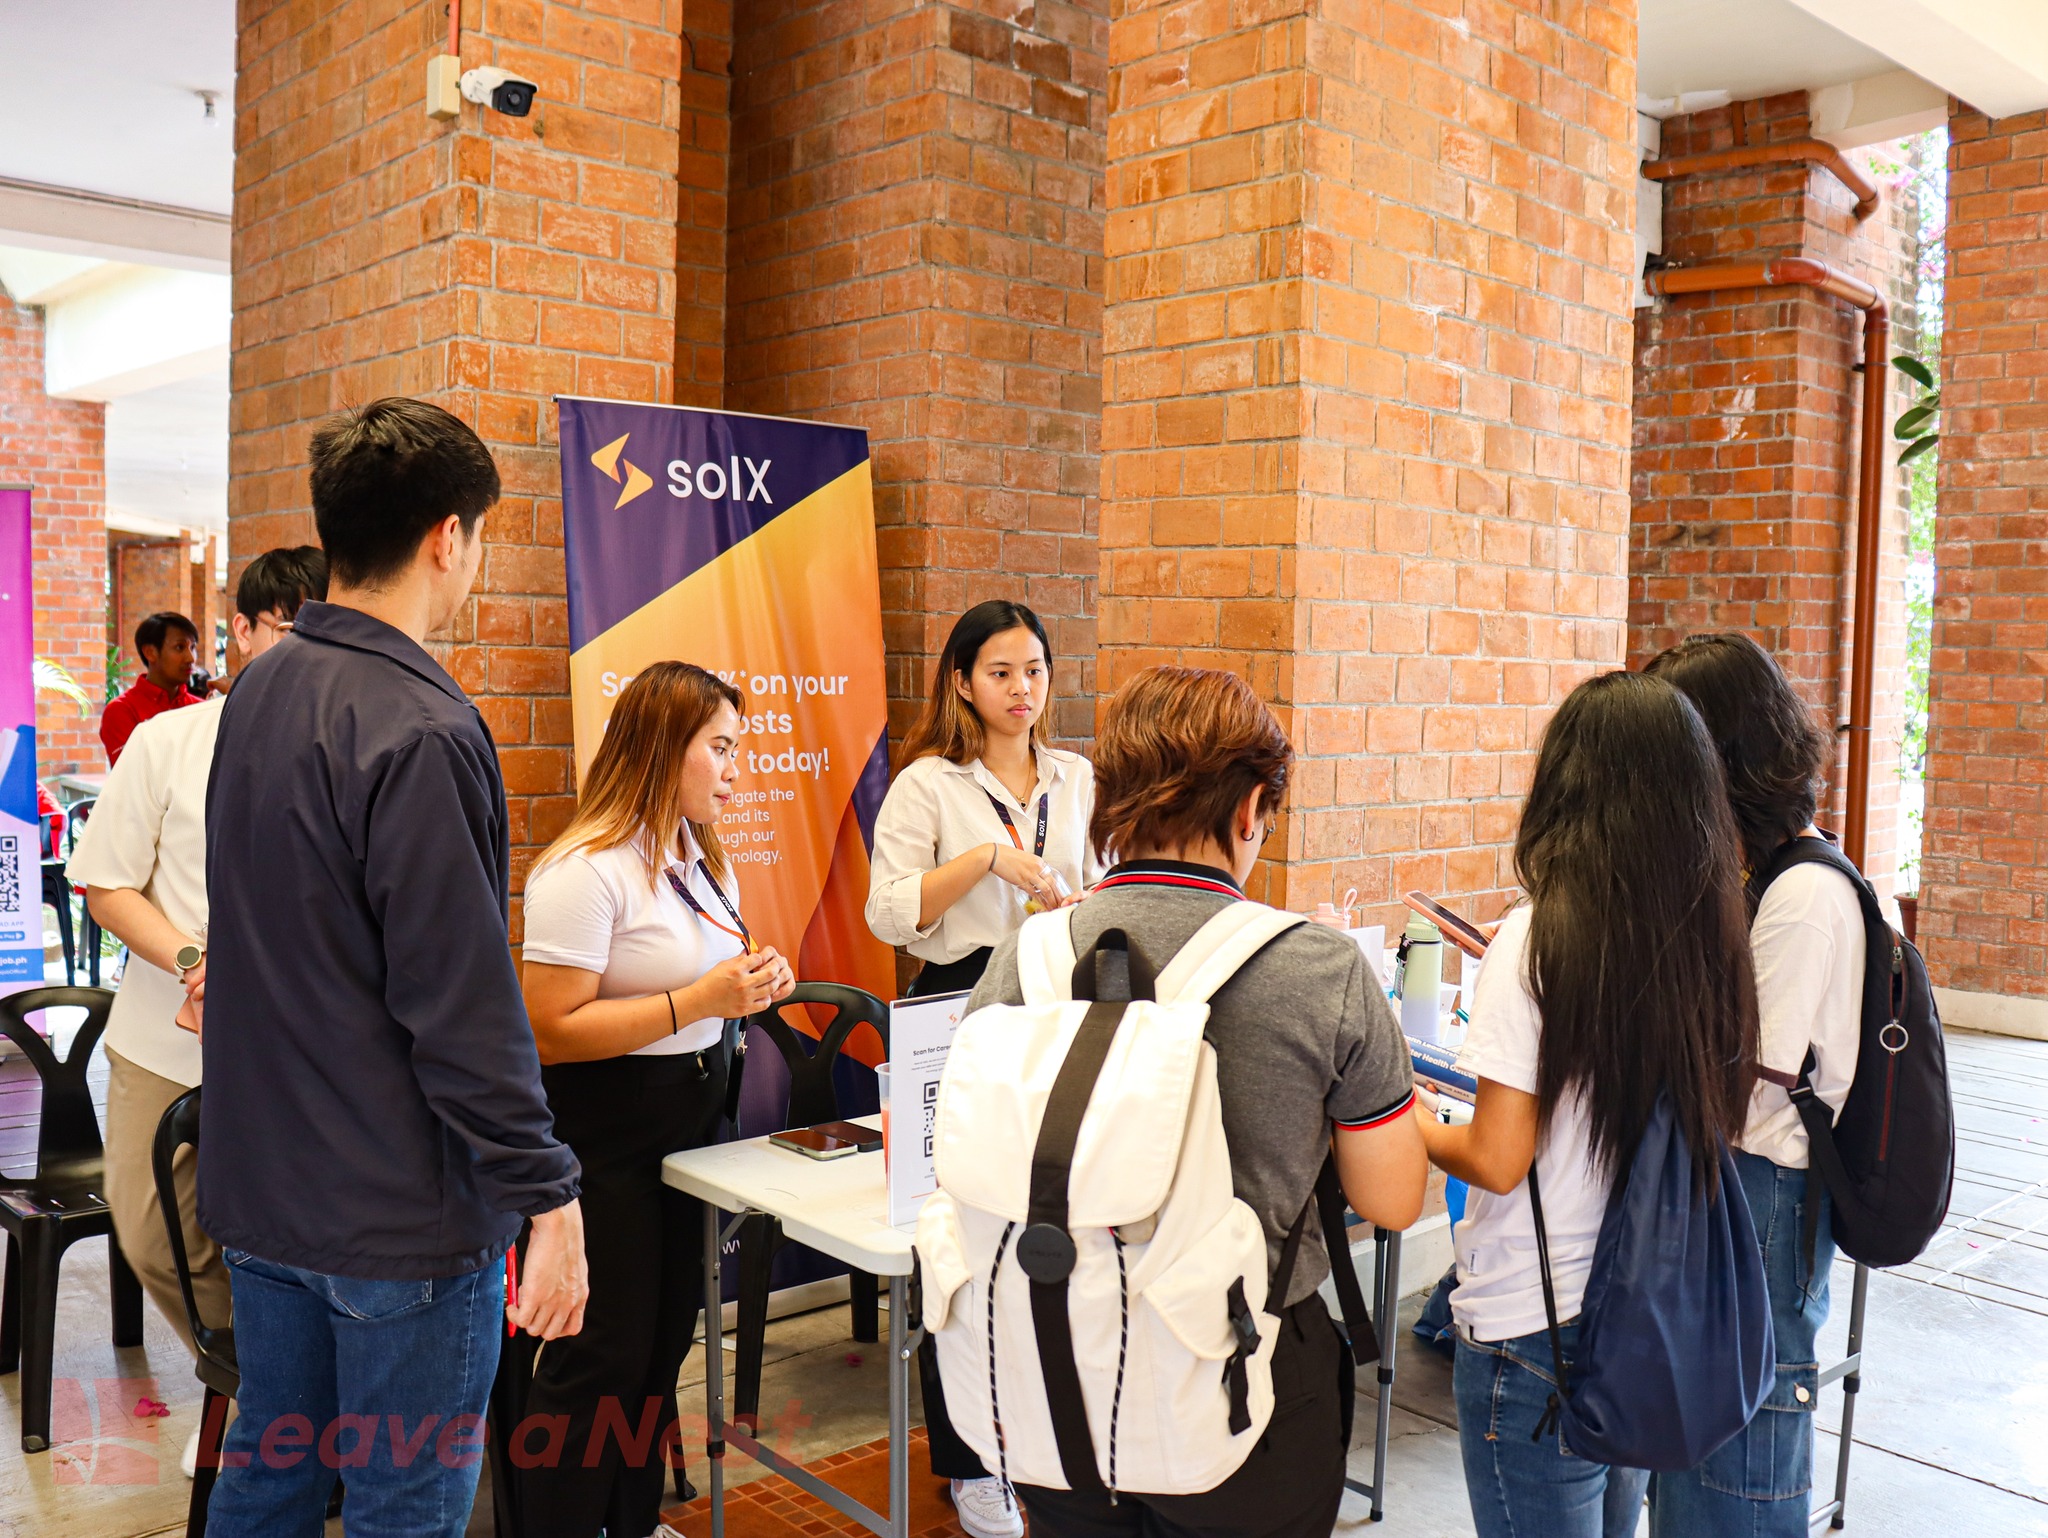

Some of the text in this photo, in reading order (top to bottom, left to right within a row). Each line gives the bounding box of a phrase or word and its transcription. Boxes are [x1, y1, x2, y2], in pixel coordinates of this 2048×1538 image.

[667, 455, 774, 505] solX
[751, 673, 787, 696] on
[792, 675, 849, 703] your
[747, 747, 830, 779] today!
[727, 788, 795, 808] igate the
[722, 808, 770, 825] and its
[752, 830, 775, 842] our
[1422, 1053, 1449, 1070] Health
